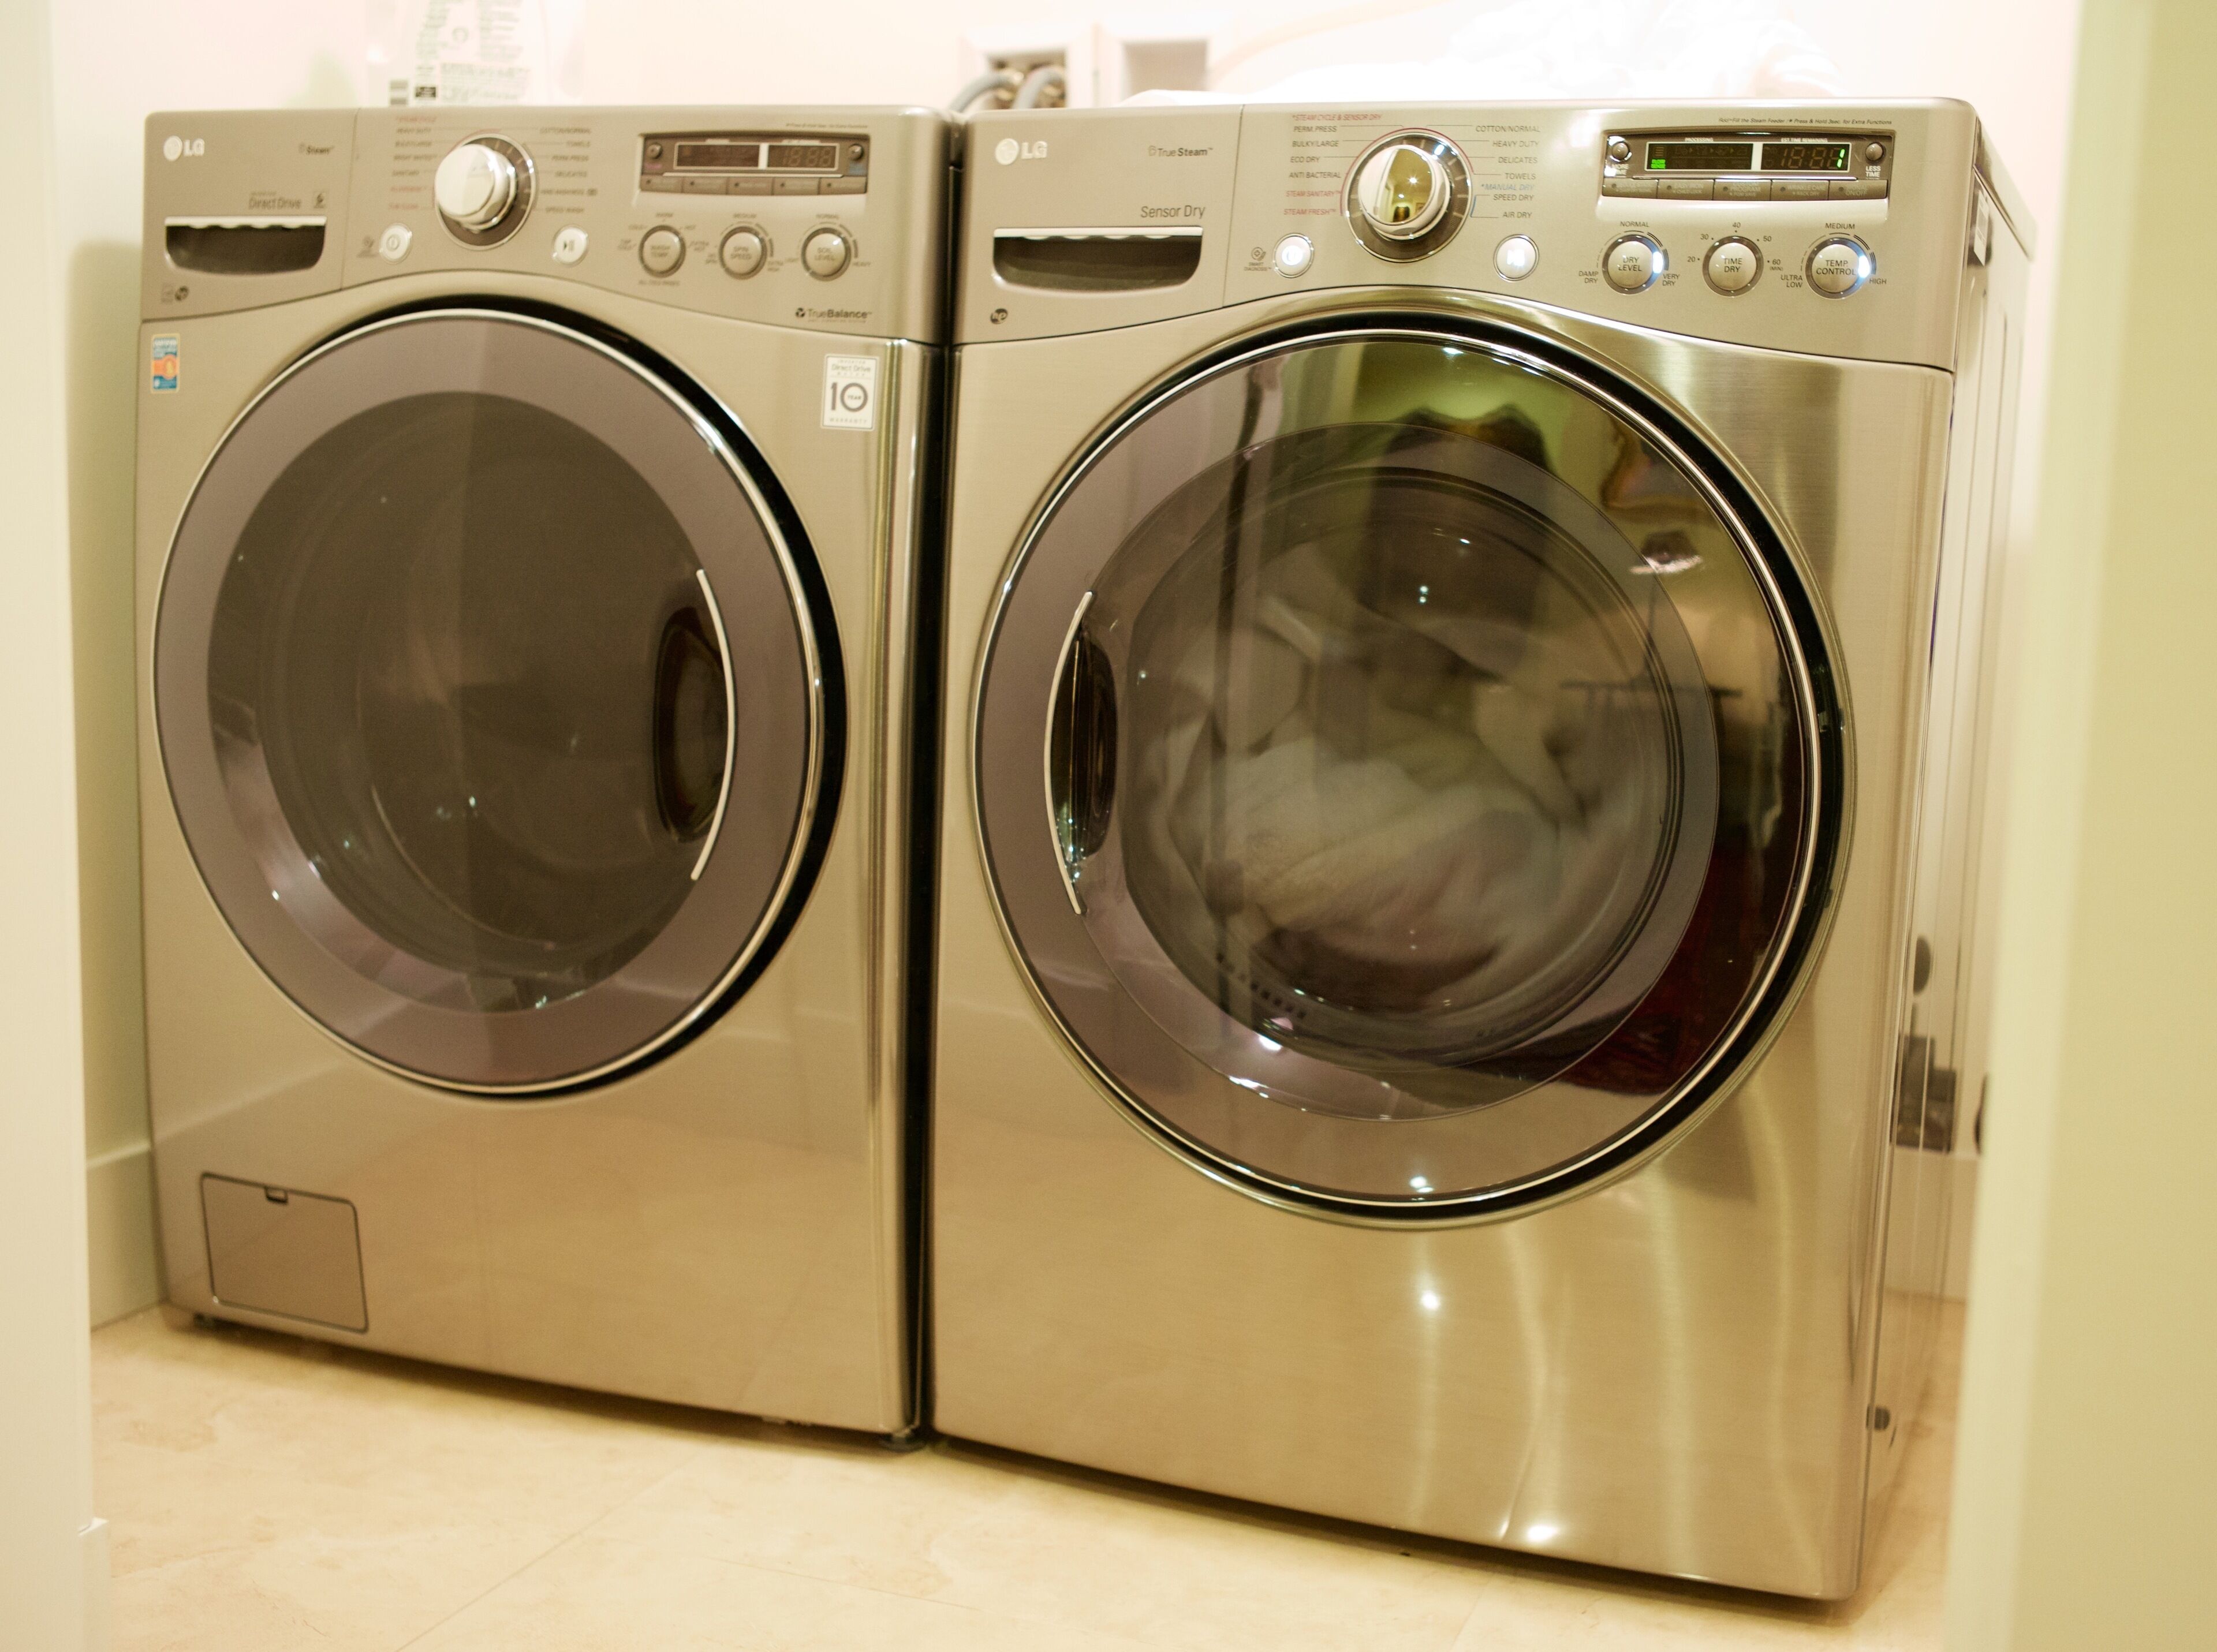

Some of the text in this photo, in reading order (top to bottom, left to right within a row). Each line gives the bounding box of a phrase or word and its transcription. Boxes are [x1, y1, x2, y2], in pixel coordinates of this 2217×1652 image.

[184, 139, 205, 156] LG
[1021, 141, 1048, 159] LG
[249, 196, 301, 210] Direct Drive
[1141, 204, 1205, 219] Sensor Dry
[831, 382, 868, 412] 10
